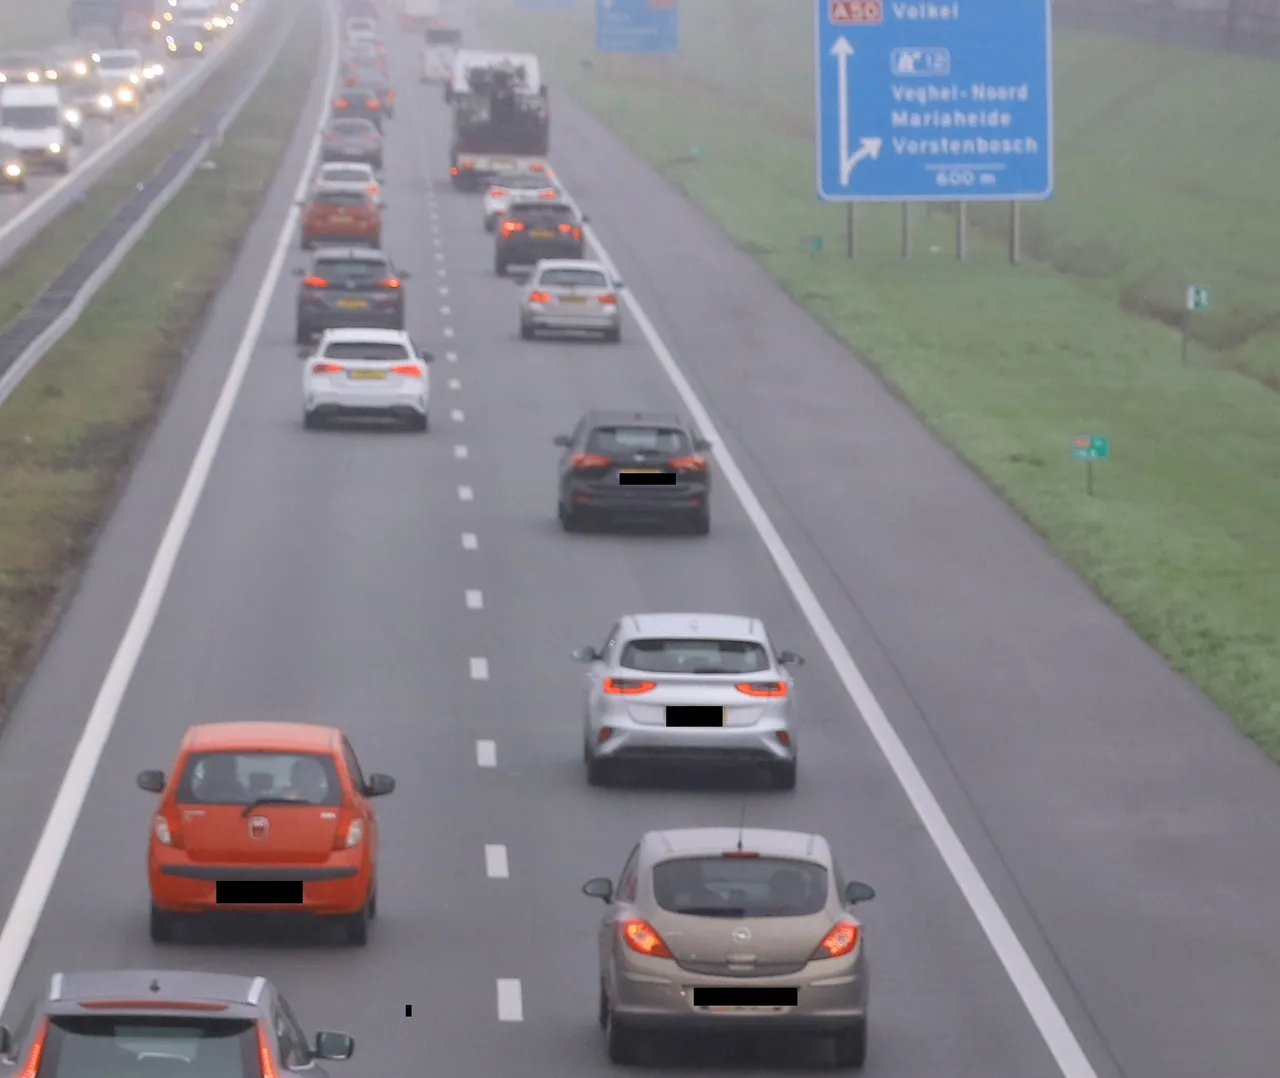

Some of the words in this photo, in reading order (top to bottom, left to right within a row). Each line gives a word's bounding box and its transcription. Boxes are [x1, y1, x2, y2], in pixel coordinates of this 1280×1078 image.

[892, 1, 958, 20] Volkel
[892, 110, 1011, 127] Mariaheide
[892, 136, 1038, 154] Vorstenbosch
[936, 172, 974, 186] 600
[979, 174, 996, 185] m
